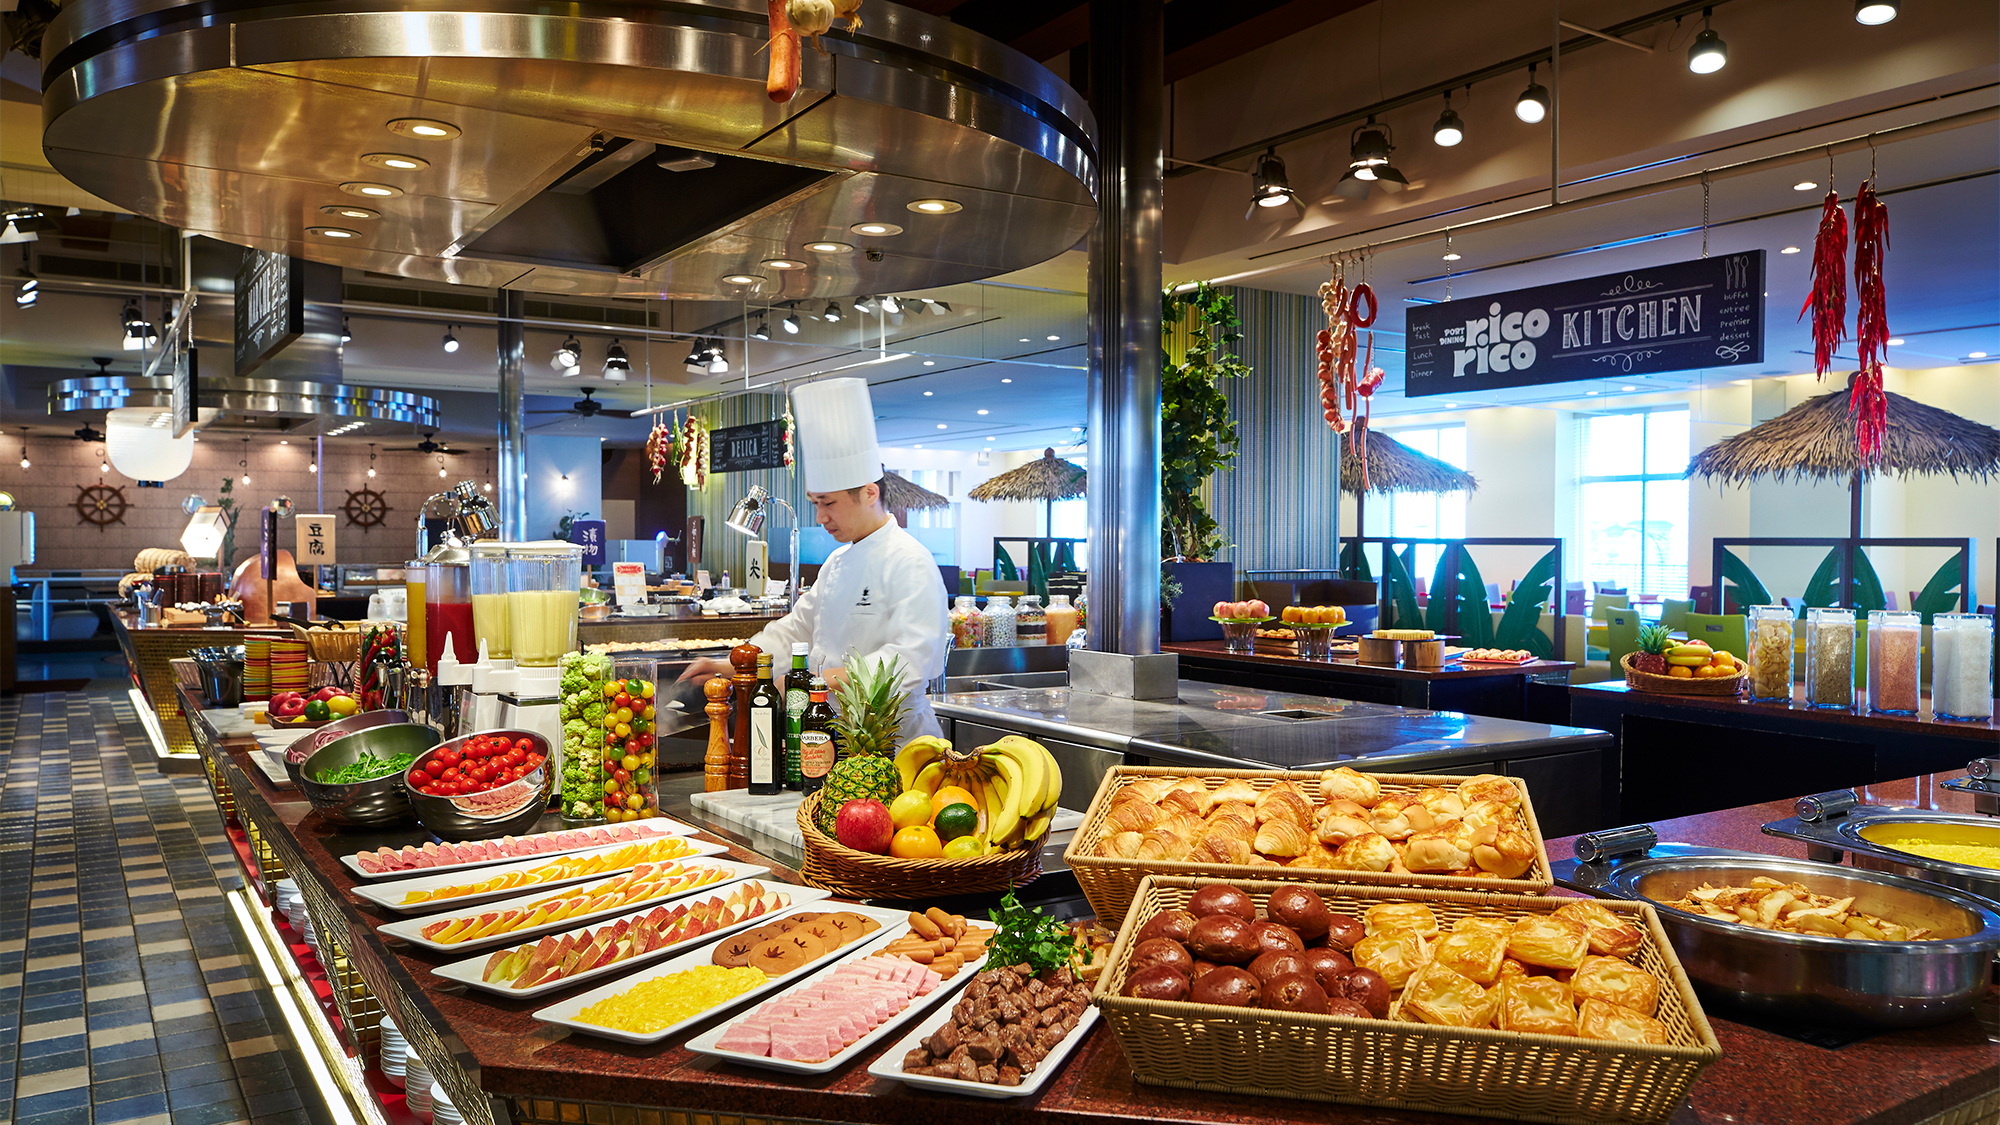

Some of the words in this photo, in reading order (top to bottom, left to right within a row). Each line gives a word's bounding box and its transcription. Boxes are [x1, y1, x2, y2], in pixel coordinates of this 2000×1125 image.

[1412, 322, 1431, 332] break
[1465, 302, 1550, 347] rico
[1562, 294, 1702, 349] KITCHEN
[1415, 332, 1430, 340] fast
[1444, 327, 1465, 337] PORT
[1720, 330, 1750, 341] dessert
[1439, 335, 1465, 346] DINING
[1413, 349, 1433, 360] Lunch
[1453, 333, 1537, 378] rico
[1410, 370, 1434, 379] Dinner
[731, 438, 758, 459] DELICA
[308, 523, 325, 556] 豆腐
[582, 527, 599, 556] 漬物
